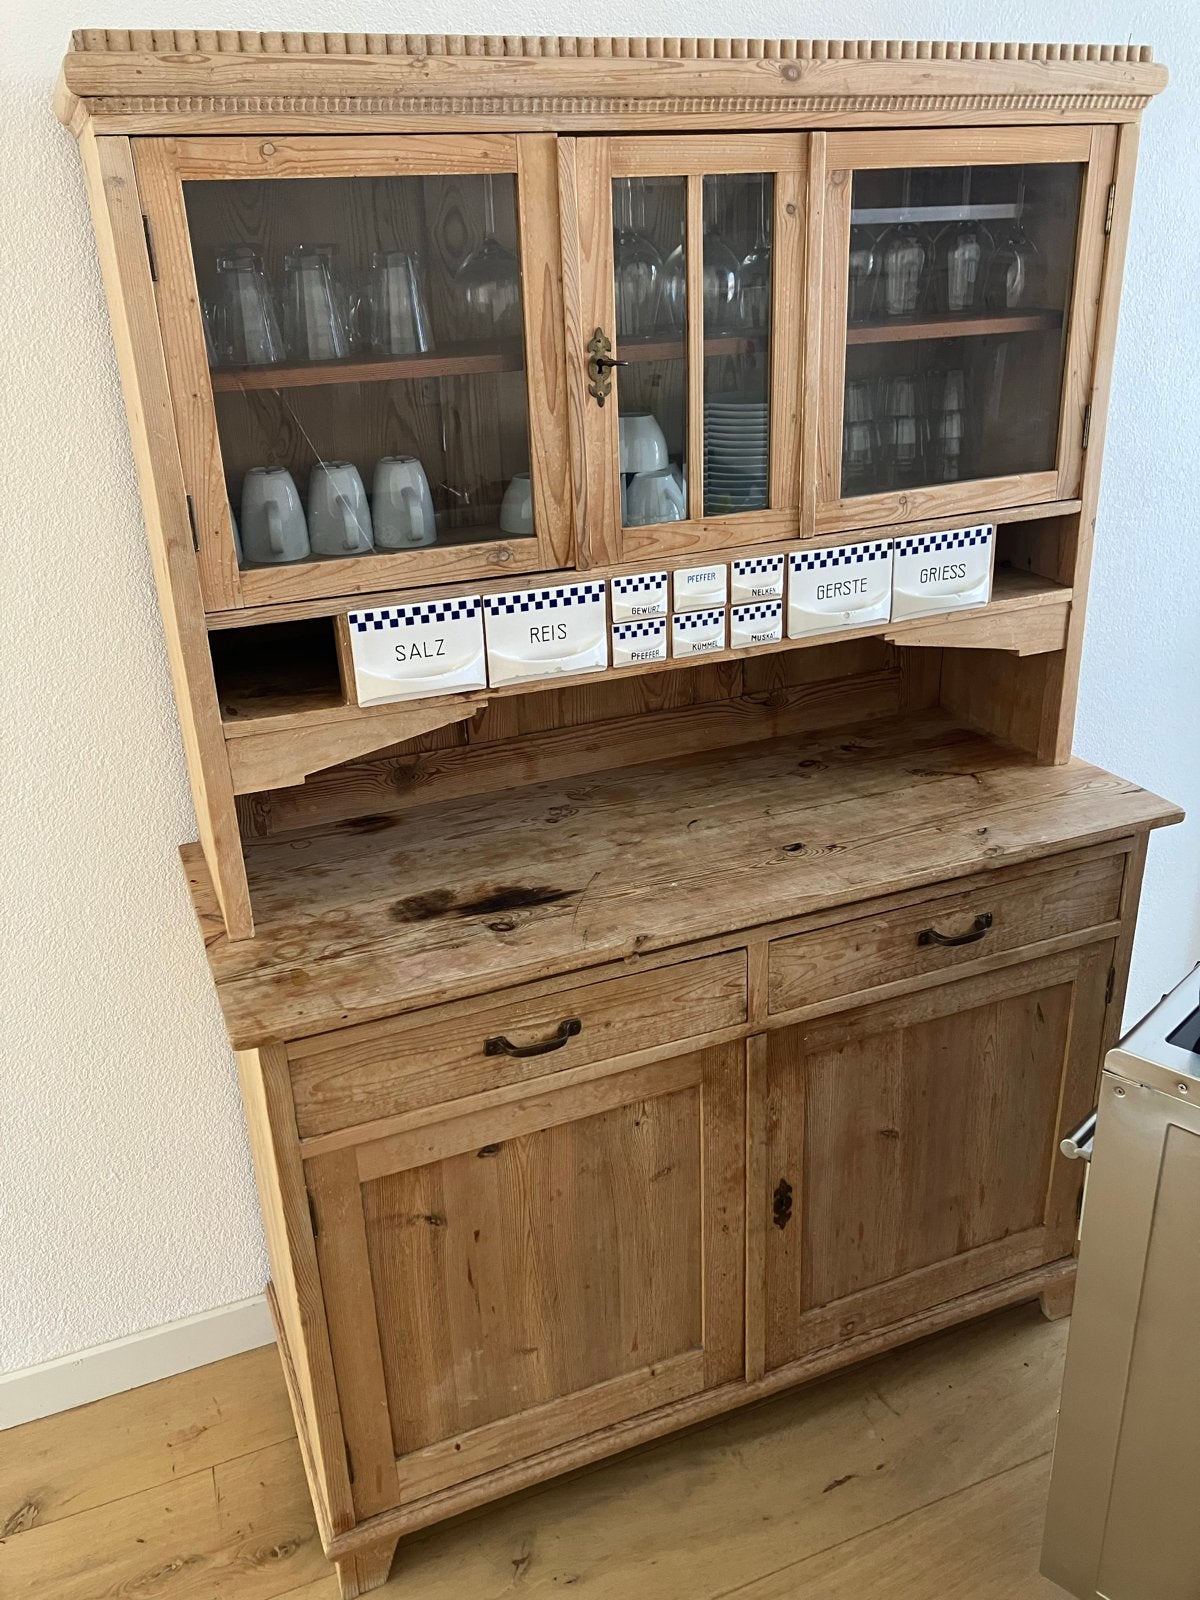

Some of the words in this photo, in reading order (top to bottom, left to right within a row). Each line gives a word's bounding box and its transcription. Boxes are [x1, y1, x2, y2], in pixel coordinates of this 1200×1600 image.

[687, 572, 716, 584] PFEFFER
[919, 563, 967, 584] GRIESS
[751, 587, 777, 597] NELKEN
[816, 578, 868, 600] GERSTE
[529, 623, 567, 644] REIS
[751, 631, 777, 642] MUSKAT
[395, 639, 446, 662] SALZ
[631, 650, 660, 661] PFEFFER
